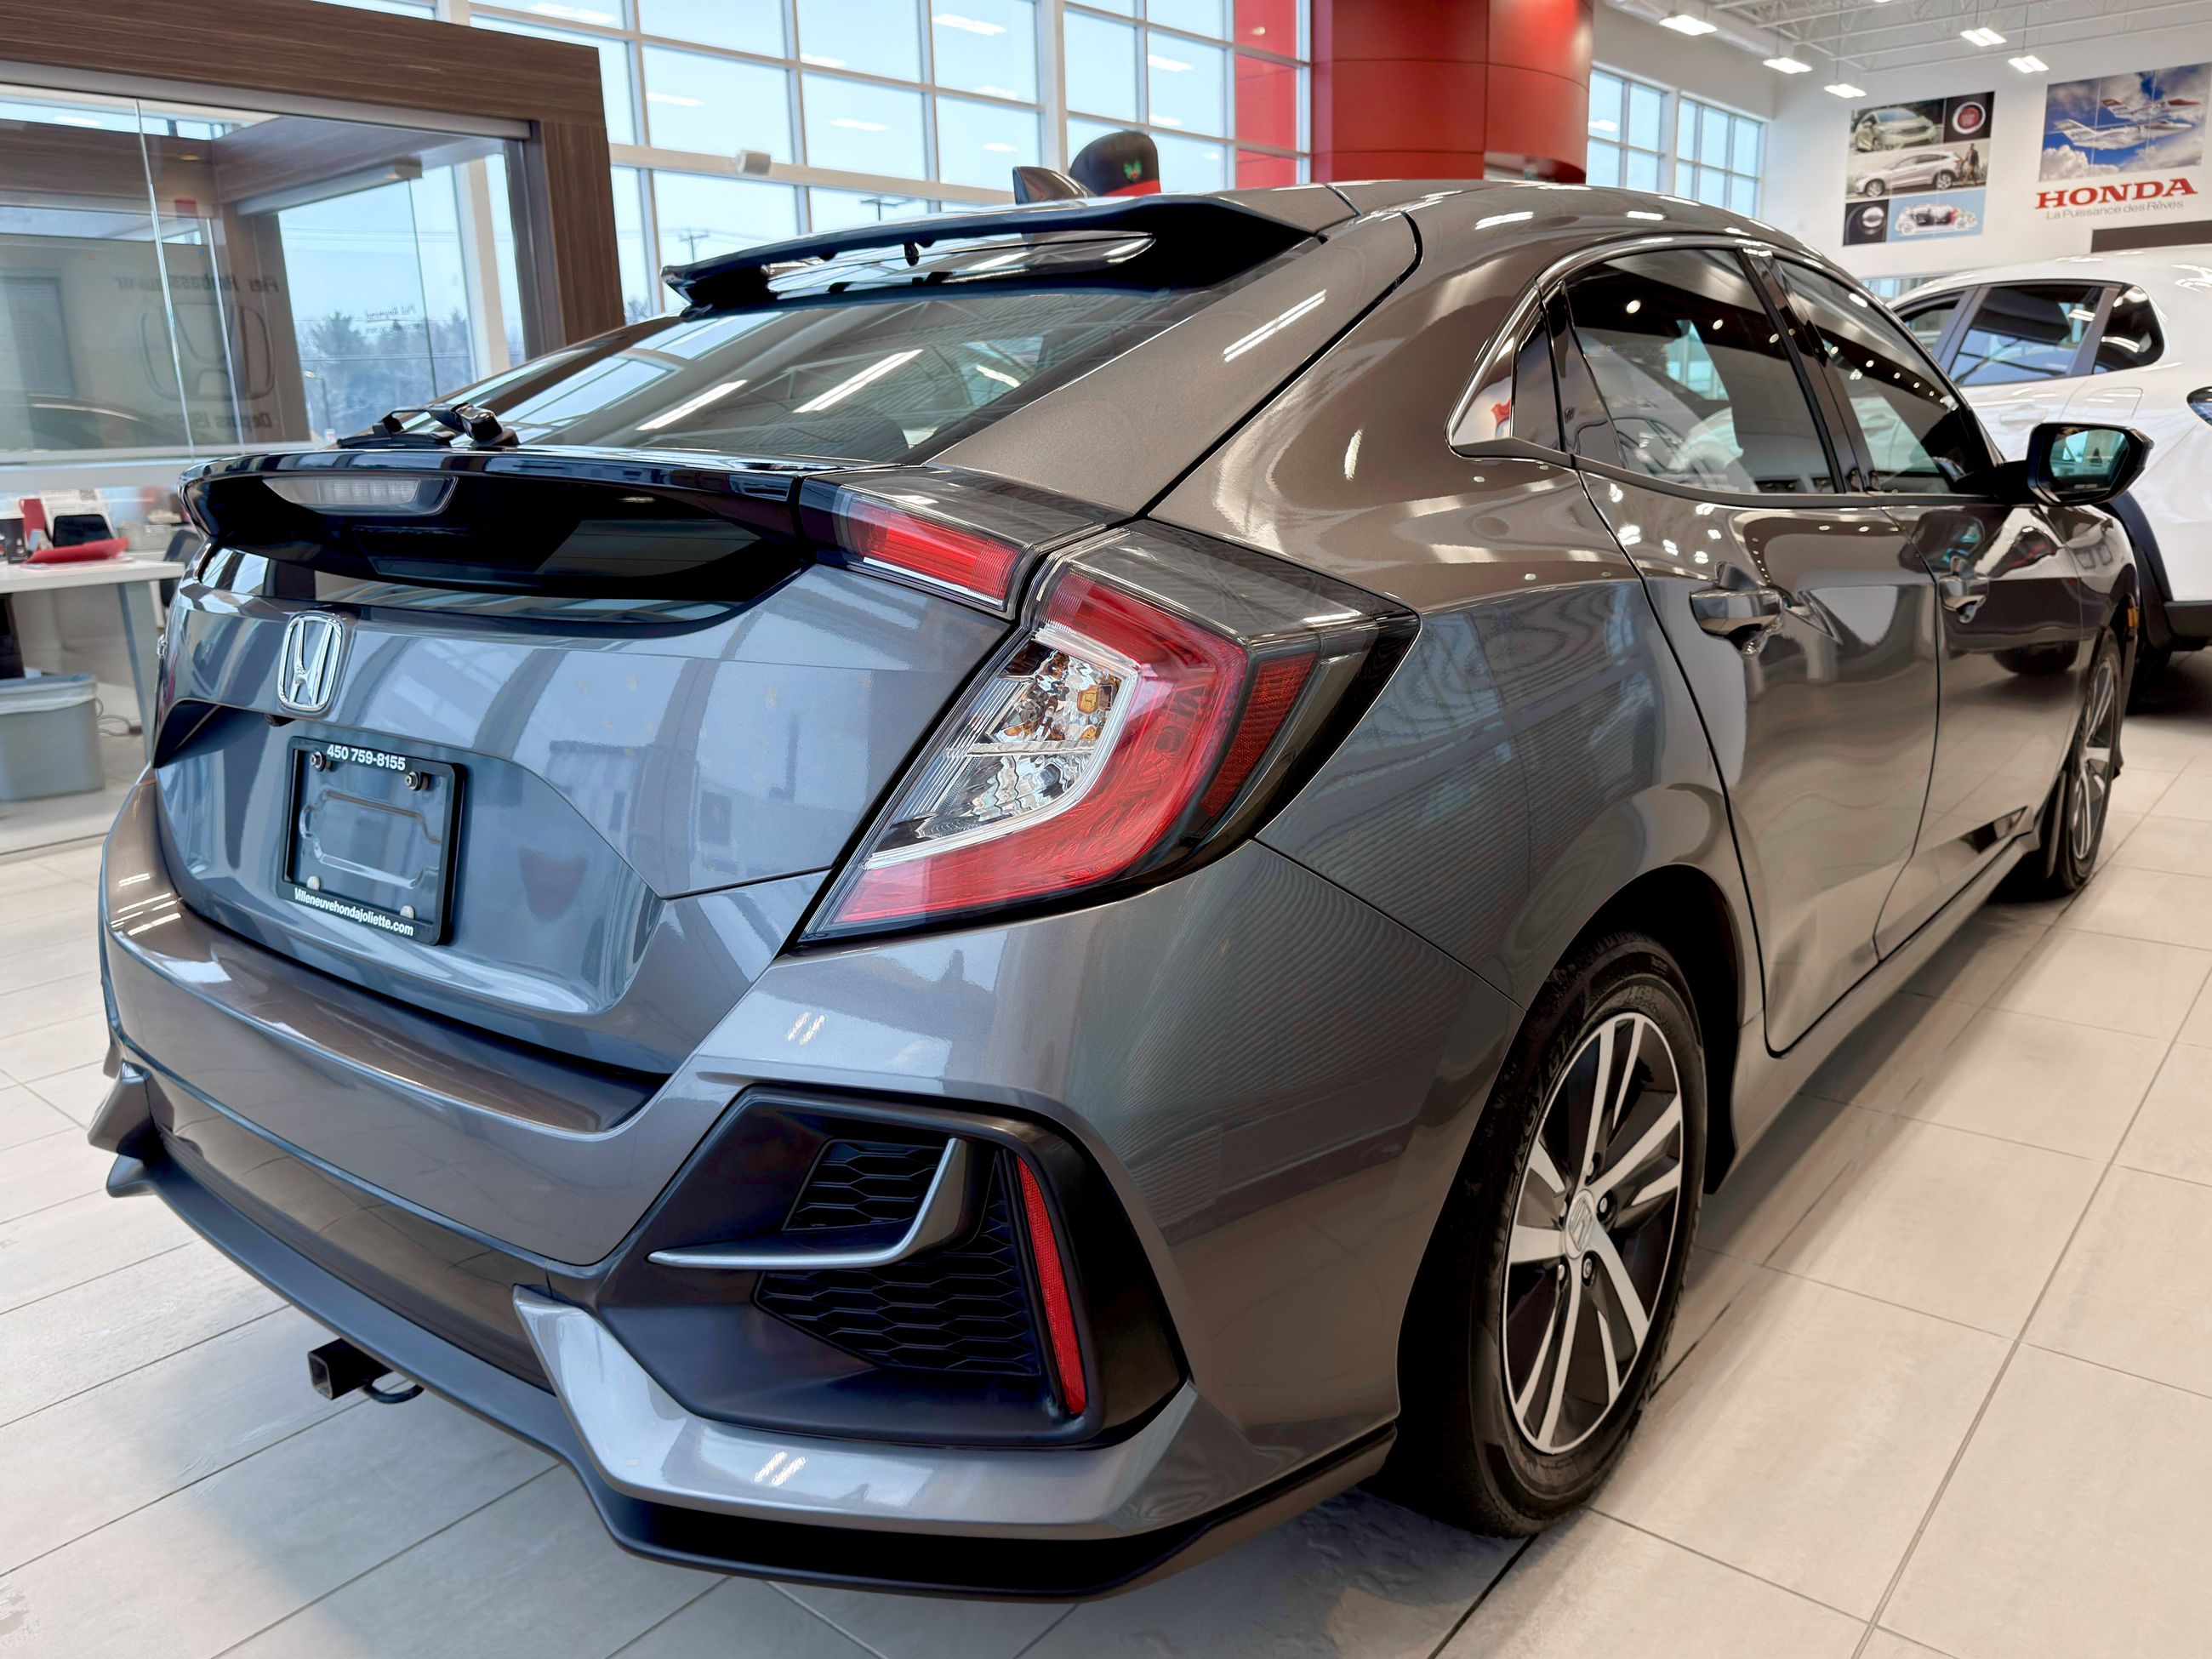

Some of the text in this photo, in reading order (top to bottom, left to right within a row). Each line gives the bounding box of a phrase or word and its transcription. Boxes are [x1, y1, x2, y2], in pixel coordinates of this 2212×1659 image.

[2035, 177, 2198, 209] HONDA
[2045, 200, 2184, 220] La Puissance des Rêves
[327, 744, 406, 771] 450 759-8155
[294, 887, 414, 937] Villeneuvehondajoliette.com
